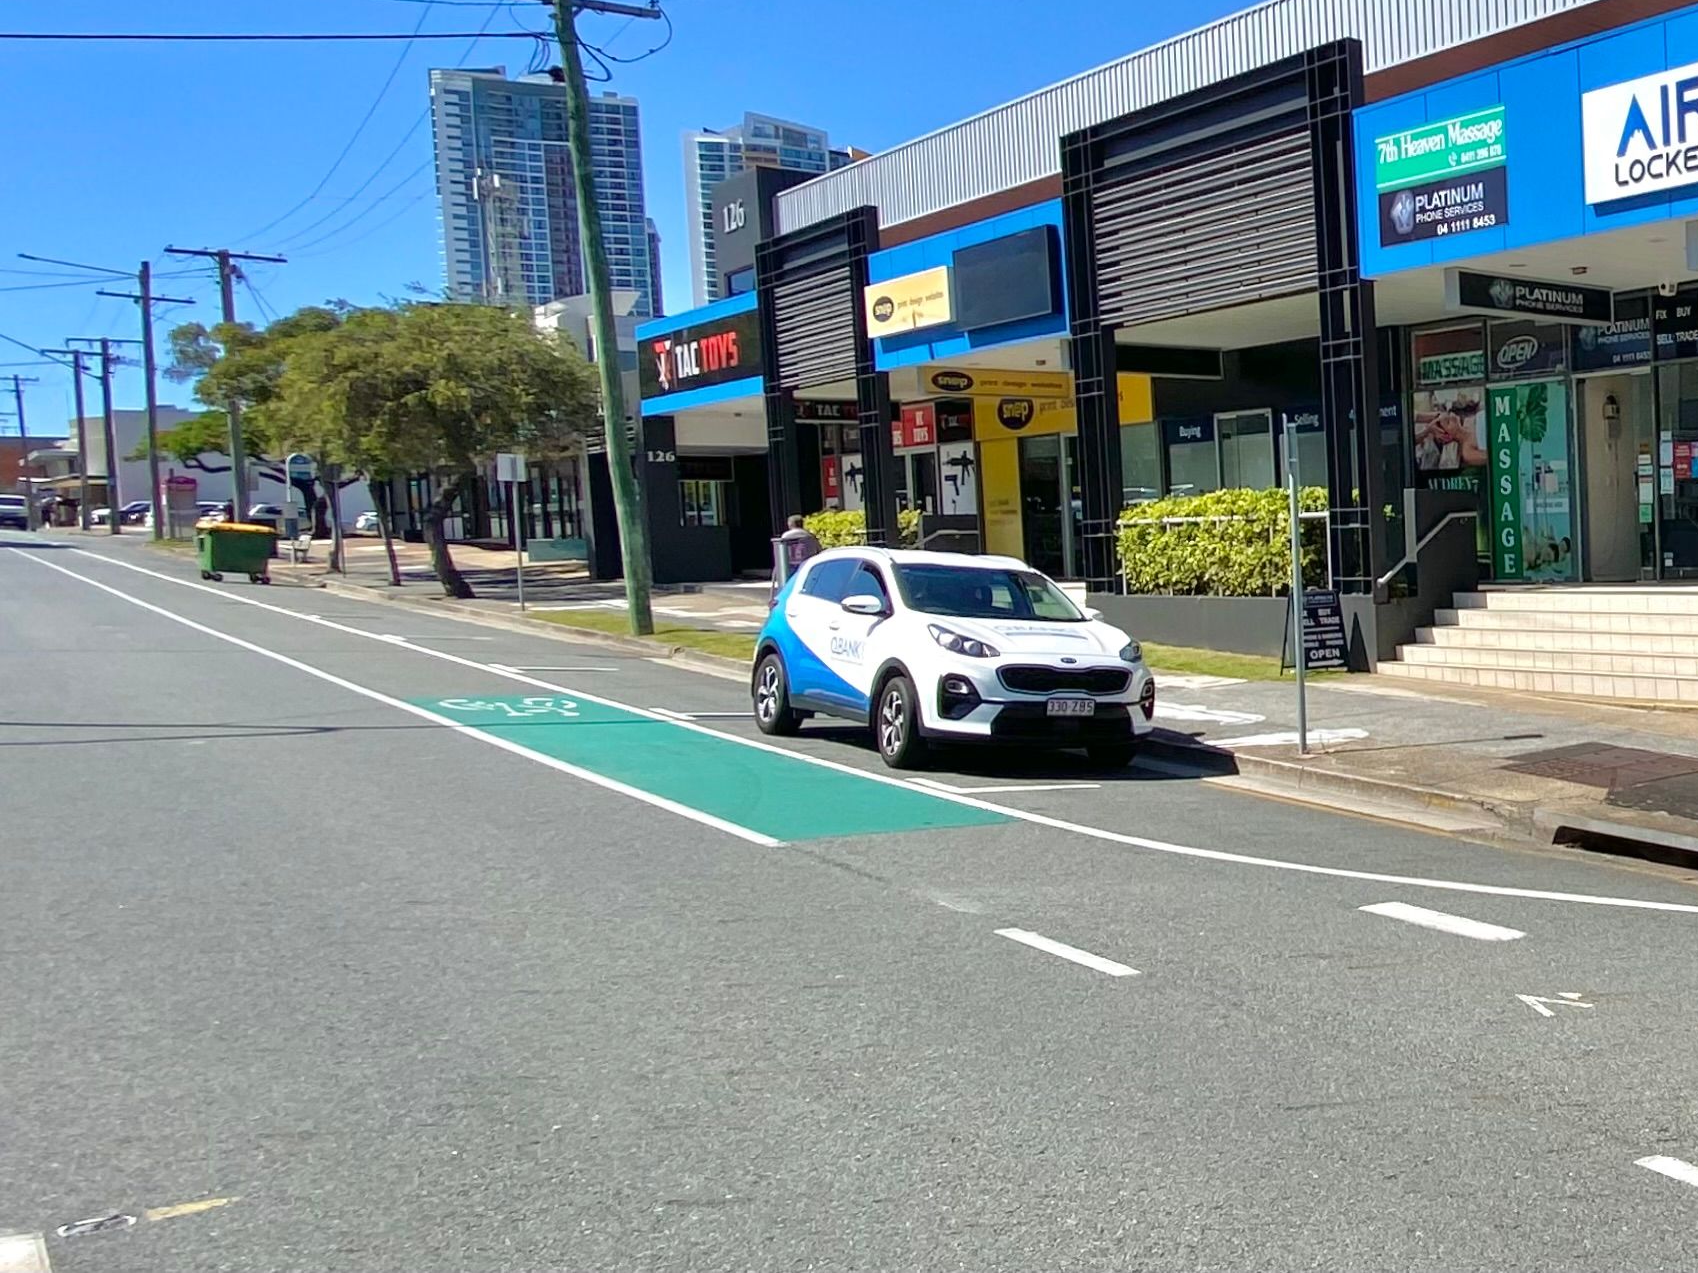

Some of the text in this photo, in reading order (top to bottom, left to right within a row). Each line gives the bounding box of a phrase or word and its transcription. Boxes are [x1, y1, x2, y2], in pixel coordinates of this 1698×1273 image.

[1378, 119, 1502, 164] 7th Heaven Massage
[1415, 182, 1484, 212] PLATINUM
[723, 198, 744, 233] 126
[1415, 201, 1484, 223] PHONE SERVICES
[1437, 214, 1496, 236] 04 1111 8453
[1515, 286, 1583, 304] PLATINUM
[1516, 299, 1583, 313] PHONE SERVICES
[1677, 306, 1692, 318] BUY
[1656, 330, 1698, 345] SELL TRADE
[675, 331, 740, 378] TAC TOYS
[1500, 341, 1532, 363] OPEN
[1422, 352, 1484, 381] MASSAGE
[816, 404, 840, 416] TAC
[1294, 413, 1319, 427] Selling
[647, 451, 675, 463] 126
[1495, 396, 1516, 574] MASSAGE
[1310, 648, 1340, 659] OPEN
[1049, 701, 1067, 712] 330
